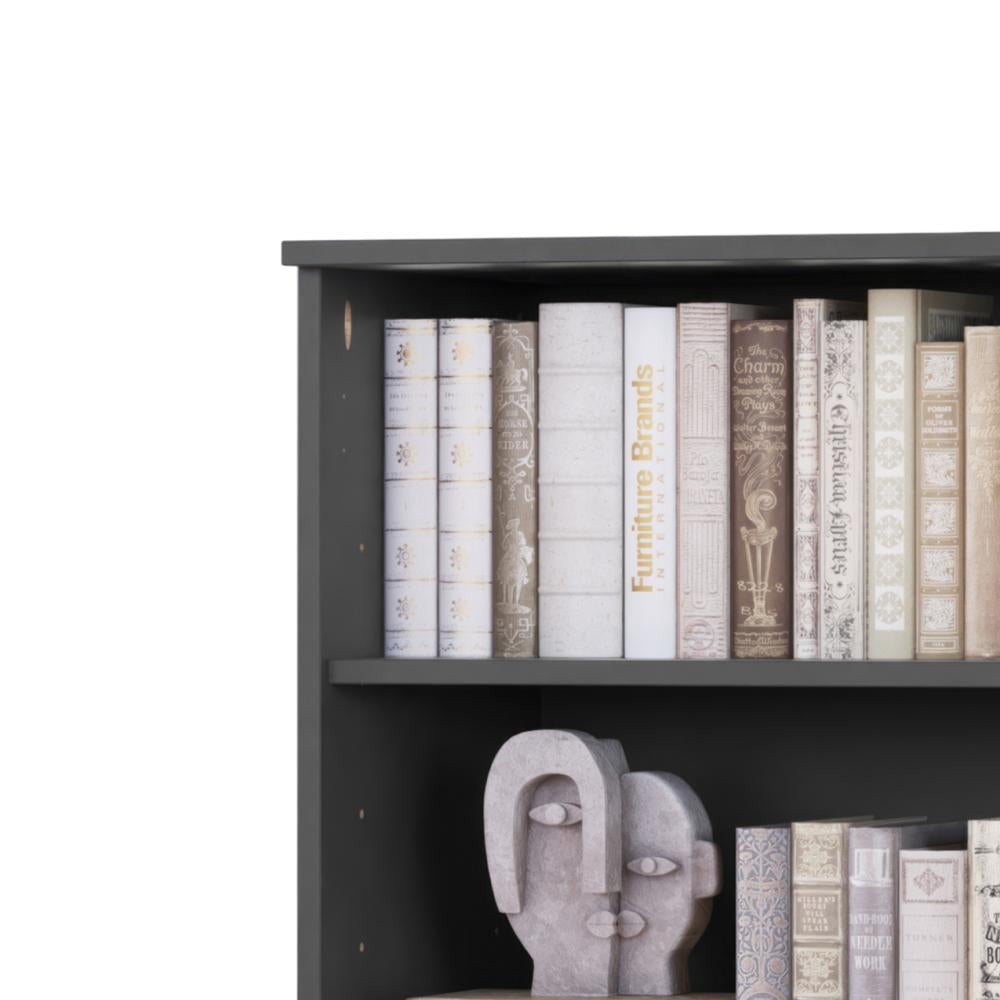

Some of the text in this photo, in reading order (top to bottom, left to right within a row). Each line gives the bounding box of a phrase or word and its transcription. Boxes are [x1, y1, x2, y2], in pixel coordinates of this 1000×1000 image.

[747, 343, 768, 356] The
[733, 357, 786, 376] Charm
[741, 396, 776, 414] Plays
[631, 363, 654, 593] Furniture Brands
[656, 363, 665, 593] INTERNATIONAL
[829, 403, 853, 577] Christian Lyrics
[854, 955, 887, 969] WORK
